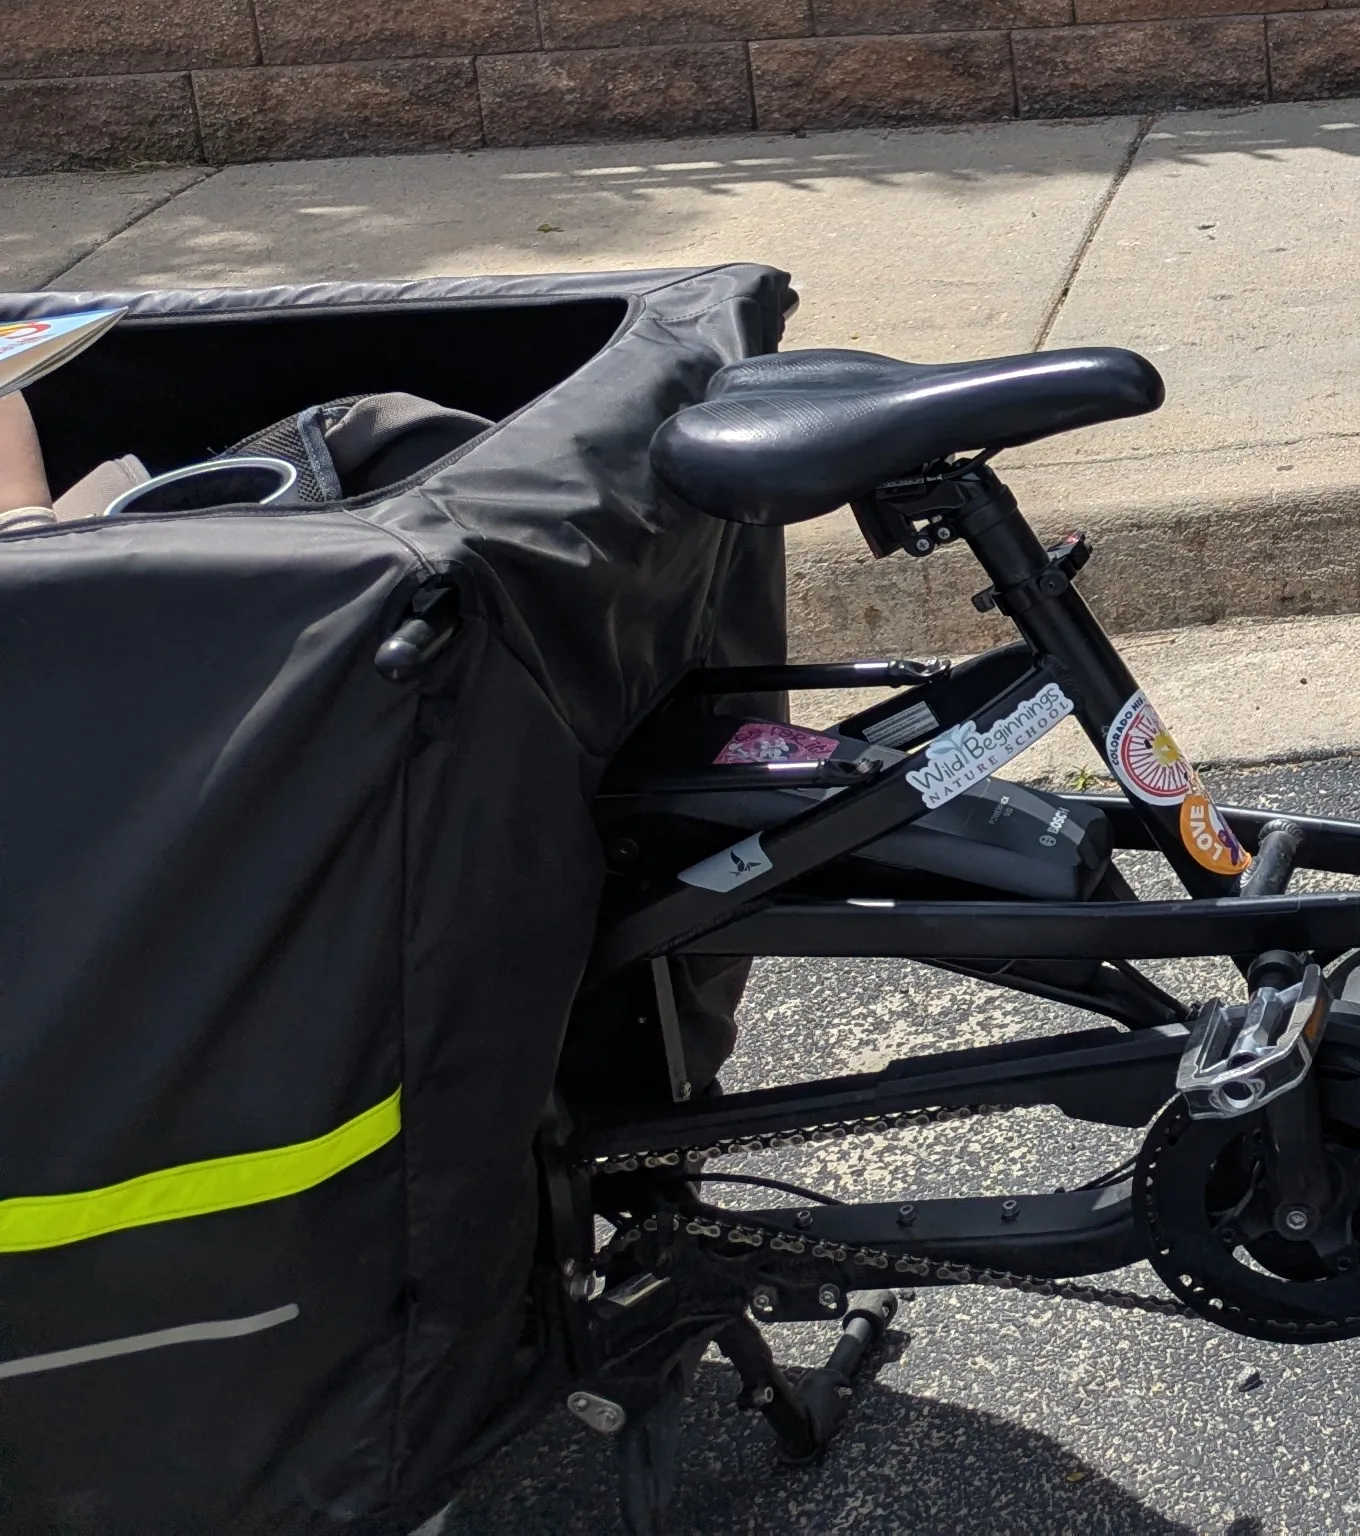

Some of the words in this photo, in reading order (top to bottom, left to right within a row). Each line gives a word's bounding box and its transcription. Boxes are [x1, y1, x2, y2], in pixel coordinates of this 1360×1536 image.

[912, 753, 965, 790] Wild
[962, 686, 1060, 761] Beginnings
[928, 755, 998, 804] NATURE
[1004, 700, 1069, 755] SCHOOL
[1109, 710, 1134, 766] COLORADO
[1047, 806, 1071, 834] BOSCH
[1189, 804, 1224, 862] LOVE
